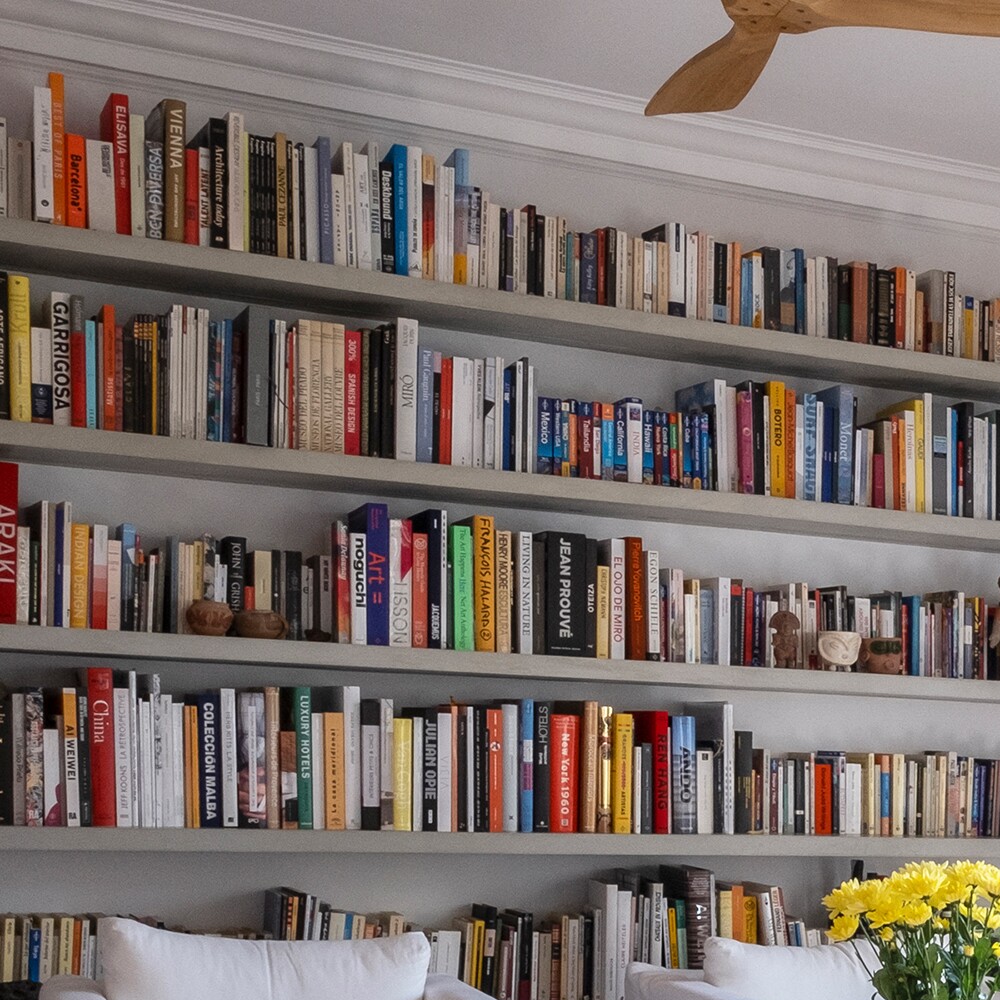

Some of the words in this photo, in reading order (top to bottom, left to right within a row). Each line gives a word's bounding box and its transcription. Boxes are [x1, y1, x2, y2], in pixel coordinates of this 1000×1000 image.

[116, 105, 128, 154] ELISAVA
[170, 109, 183, 169] VIENNA
[200, 168, 208, 198] LATENT
[215, 145, 224, 202] Architecture
[277, 166, 286, 204] CEZANNE
[382, 170, 393, 220] Deskbound
[200, 202, 209, 228] TALENT
[214, 203, 224, 227] today
[278, 206, 286, 227] PAUL
[53, 302, 70, 410] GARRIGOSA
[348, 339, 357, 362] 300%
[422, 350, 431, 367] Paul
[106, 377, 114, 405] Matisse
[299, 367, 307, 396] PRADO
[312, 358, 320, 404] FLORENCIA
[324, 376, 332, 412] GALLERY
[347, 373, 356, 404] SPANISH
[399, 375, 414, 408] MIRÓ
[422, 368, 431, 401] Gauguin
[299, 399, 307, 417] DEL
[312, 406, 319, 417] DE
[334, 406, 343, 424] DEL
[347, 407, 356, 433] DESIGN
[805, 394, 816, 442] SURF
[540, 411, 550, 444] Mexico
[582, 419, 592, 452] Tailandia
[616, 420, 625, 456] California
[632, 431, 640, 456] INDIA
[644, 423, 652, 453] Hawaii
[774, 409, 782, 446] BOTERO
[839, 422, 852, 461] Monet
[75, 527, 84, 569] INDIAN
[231, 542, 241, 568] JOHN
[339, 545, 347, 580] Delaunay
[480, 518, 490, 576] FRANÇOIS
[498, 534, 508, 560] HENRY
[522, 535, 530, 573] LIVING
[560, 538, 570, 575] JEAN
[614, 556, 622, 568] EL
[632, 542, 641, 569] Pierre
[354, 538, 365, 607] noguchi
[368, 552, 385, 584] Art
[498, 561, 508, 590] MOORE
[522, 577, 530, 588] IN
[614, 571, 622, 594] OJO
[649, 552, 658, 583] EGON
[74, 575, 84, 619] DESIGN
[480, 580, 490, 627] HALARD
[560, 580, 572, 638] PROUVÉ
[614, 598, 622, 612] DE
[633, 569, 643, 621] Yovanovitch
[650, 588, 658, 635] SCHIELE
[431, 603, 439, 640] JACQUEMUS
[522, 592, 530, 636] NATURE
[614, 614, 624, 642] MIRÓ
[66, 725, 74, 736] AI
[93, 700, 109, 743] China
[300, 695, 309, 735] LUXURY
[538, 706, 548, 743] HOTELS
[204, 703, 216, 773] COLECCIÓN
[425, 720, 436, 766] JULIAN
[561, 733, 570, 756] New
[657, 734, 667, 762] REN
[301, 739, 310, 778] HOTELS
[561, 758, 570, 783] York
[680, 746, 691, 803] ANDO
[206, 776, 216, 819] MALBA
[425, 770, 436, 799] OPIE
[561, 787, 569, 815] 1960
[658, 768, 667, 810] HANG
[332, 803, 337, 813] La
